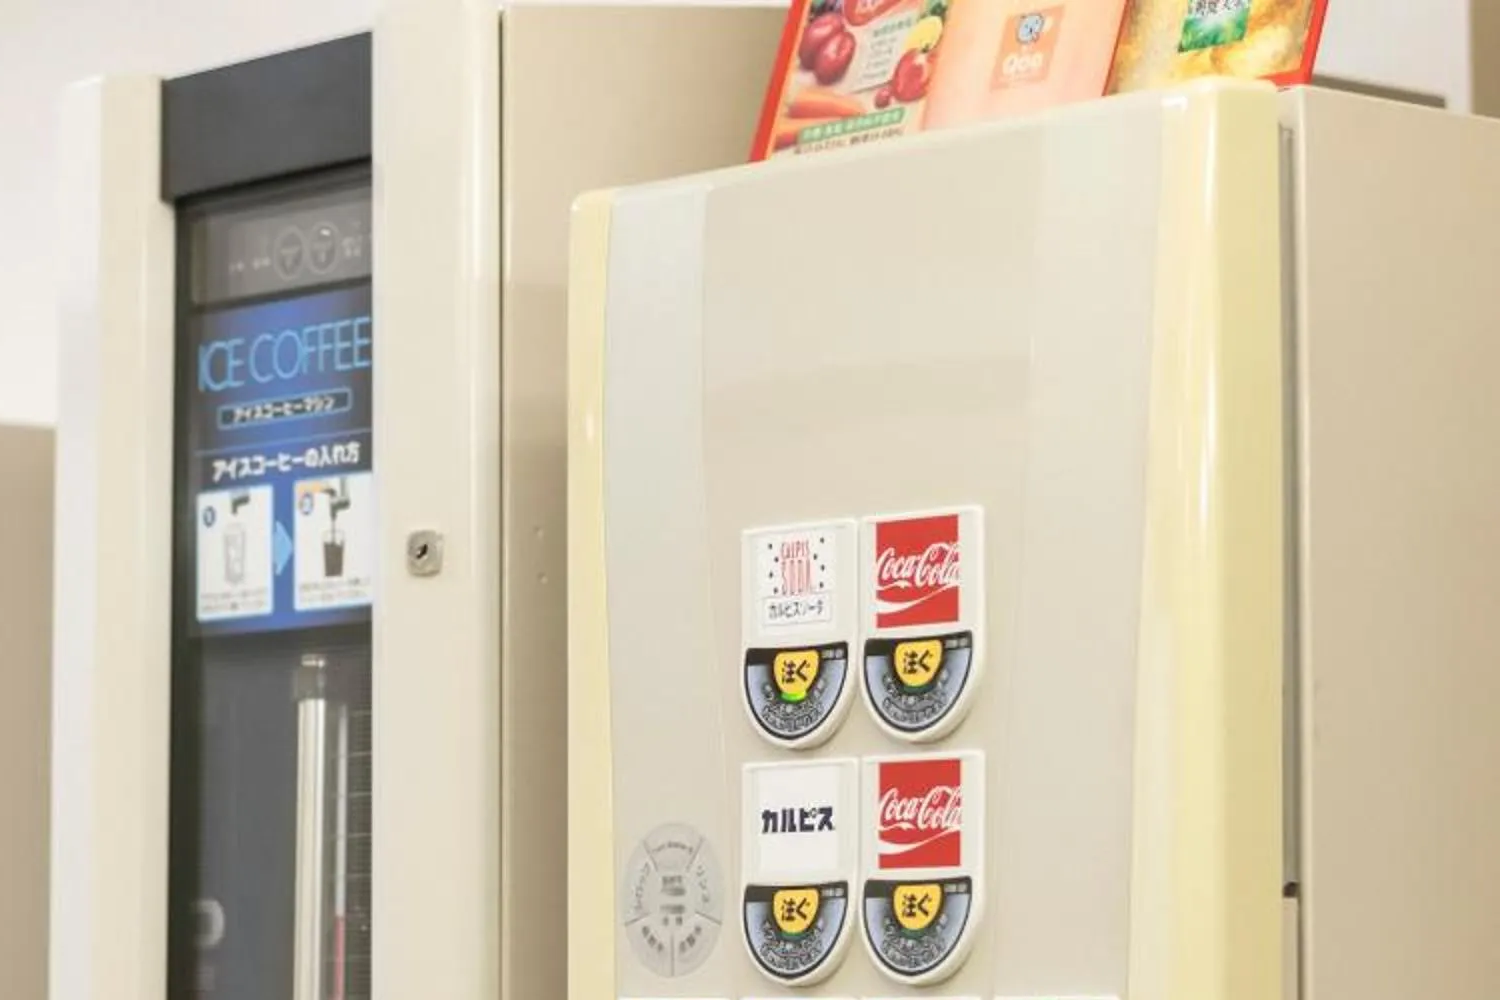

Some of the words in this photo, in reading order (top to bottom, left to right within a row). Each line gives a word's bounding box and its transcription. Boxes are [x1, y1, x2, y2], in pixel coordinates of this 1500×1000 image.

[199, 338, 245, 391] ICE
[250, 316, 372, 383] COFFEE
[212, 441, 361, 482] アイスコーヒーの入れ方
[876, 543, 962, 589] Coca-Cola
[761, 806, 835, 834] カルピス
[877, 785, 964, 831] Coca-Cola
[781, 897, 809, 922] 注ぐ
[902, 893, 930, 919] 注ぐ
